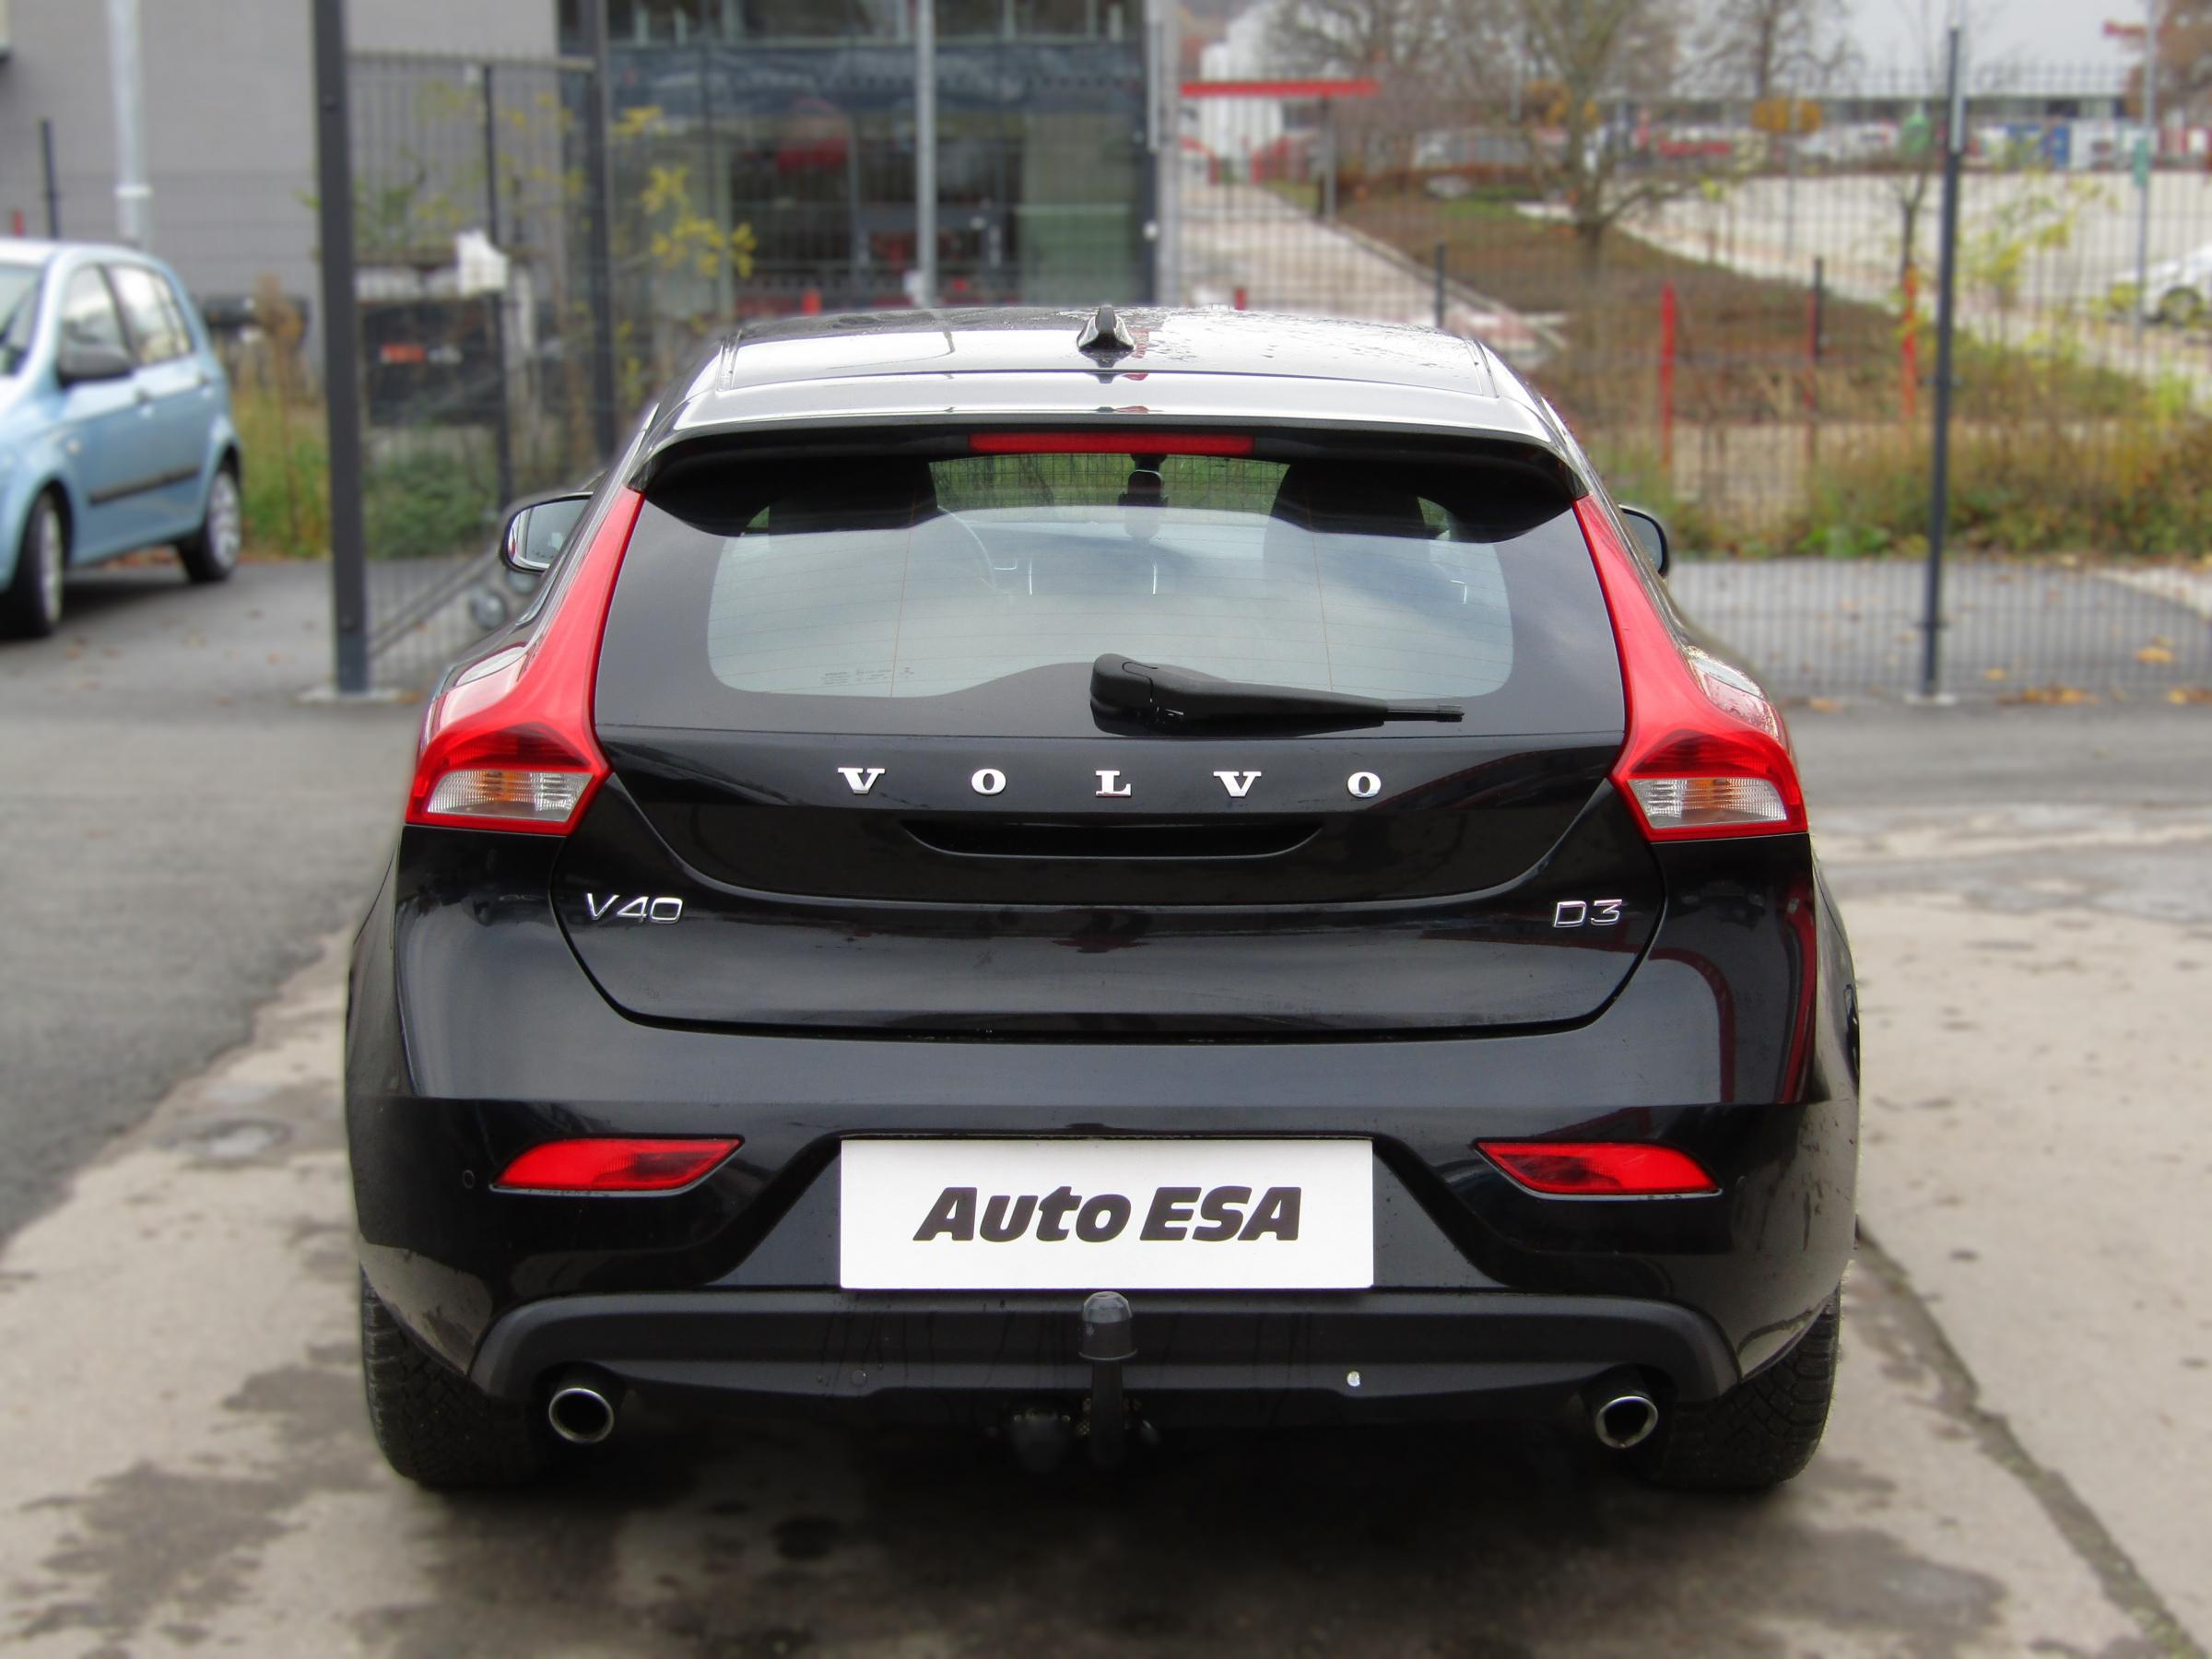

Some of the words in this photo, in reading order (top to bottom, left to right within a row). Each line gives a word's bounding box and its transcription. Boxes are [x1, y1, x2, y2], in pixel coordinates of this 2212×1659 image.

[838, 767, 1382, 797] VOLVO
[586, 892, 683, 924] V40
[1553, 899, 1623, 928] D3
[912, 1185, 1132, 1243] Auto
[1139, 1185, 1301, 1242] ESA
